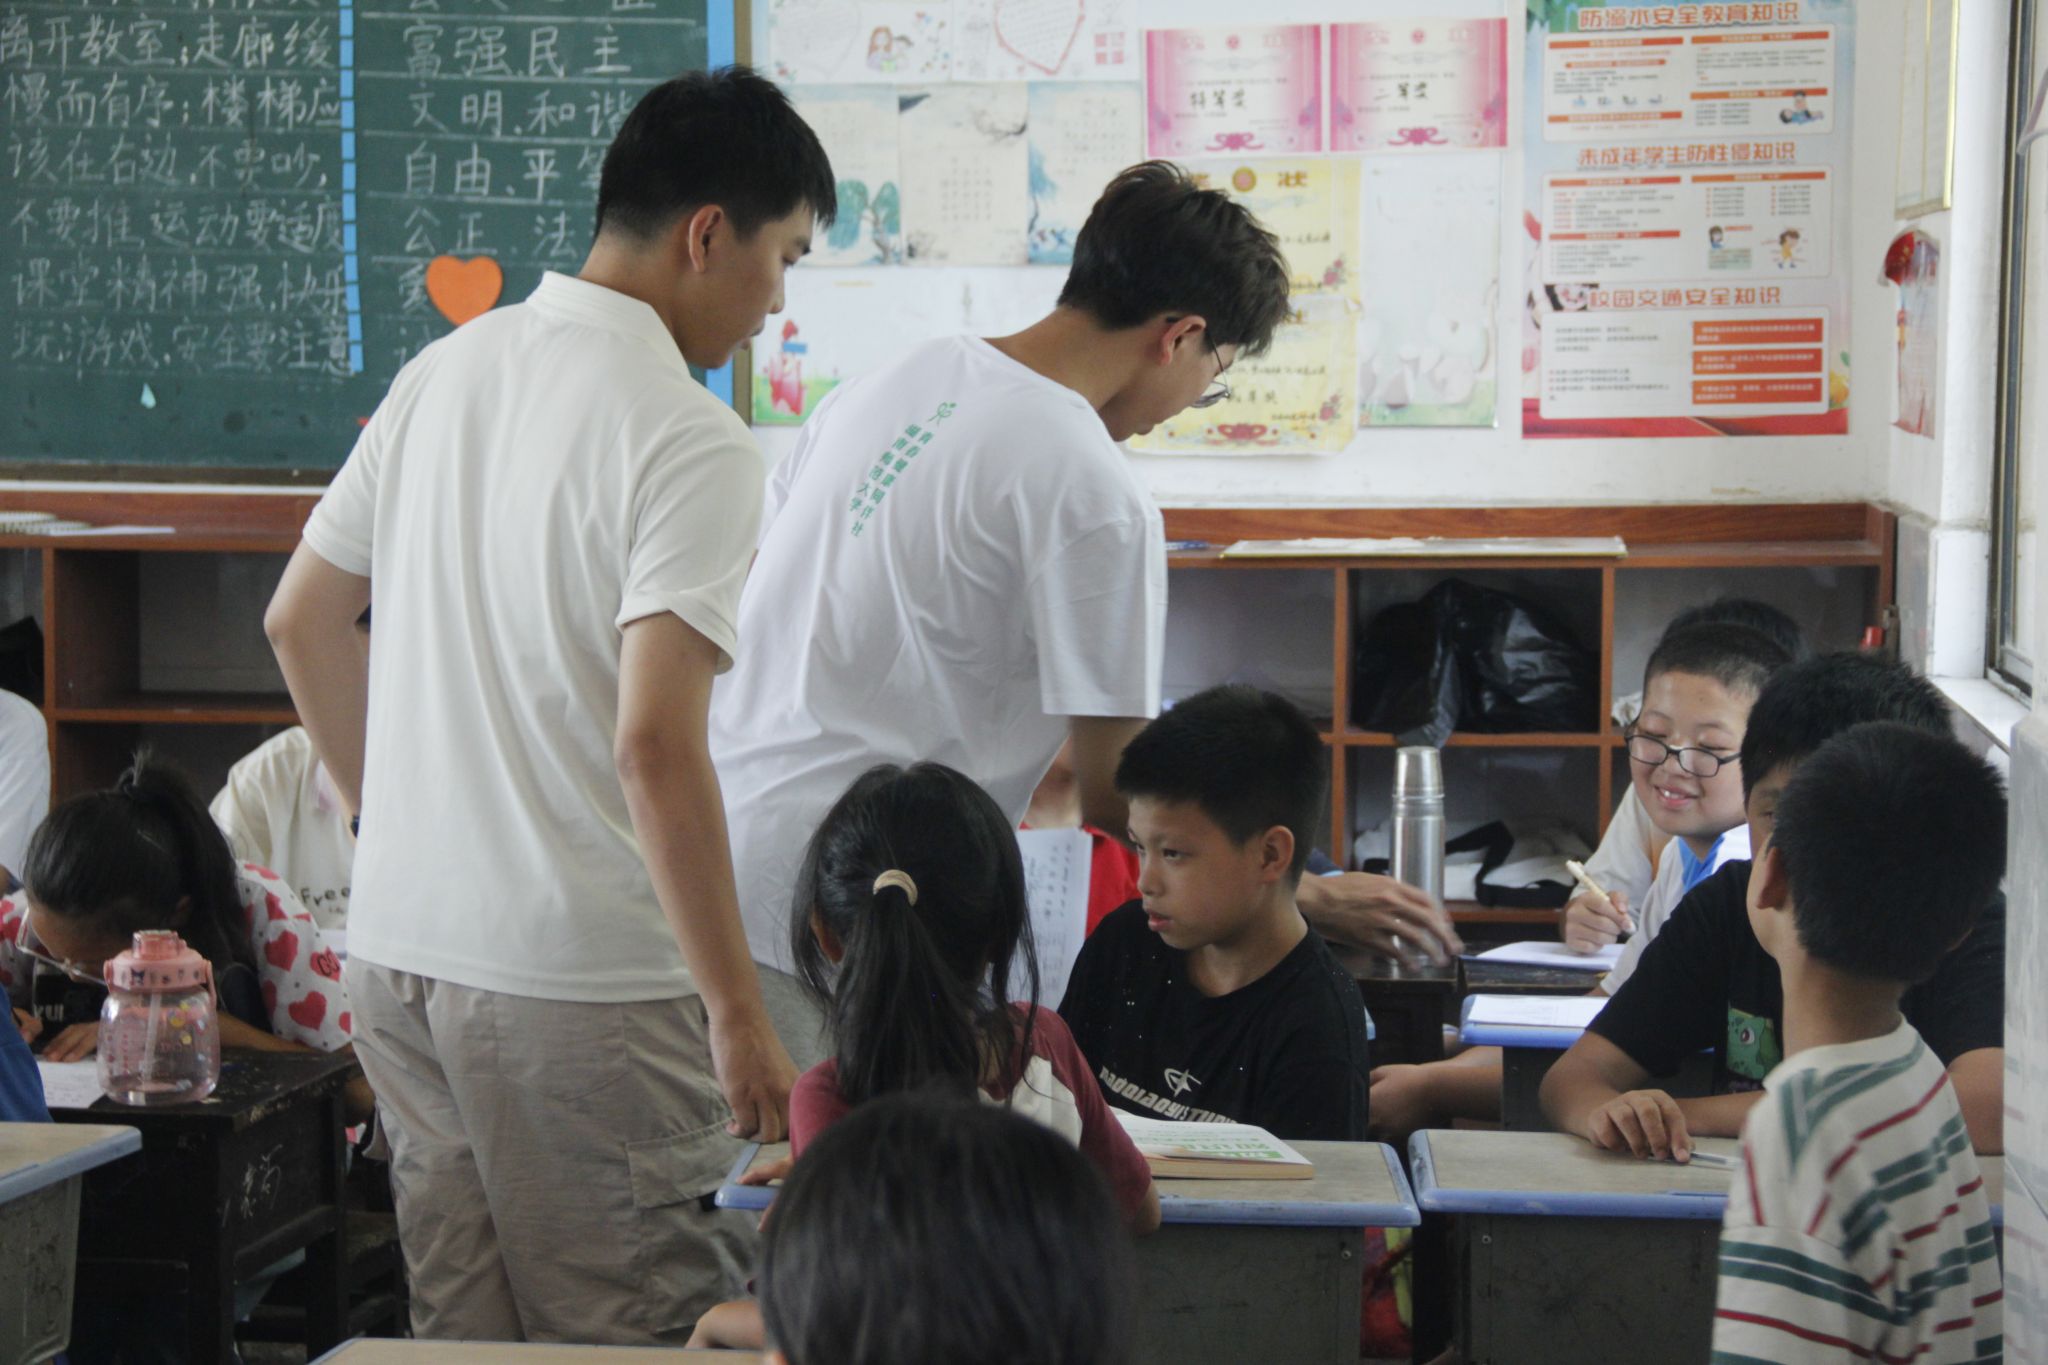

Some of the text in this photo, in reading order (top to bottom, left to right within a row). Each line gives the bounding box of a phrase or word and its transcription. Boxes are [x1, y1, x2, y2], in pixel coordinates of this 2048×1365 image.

[1578, 3, 1799, 29] 防溺水安全教育知识
[1577, 141, 1797, 167] 未成年学生防性侵知识
[1589, 286, 1782, 309] 校园交通安全知识
